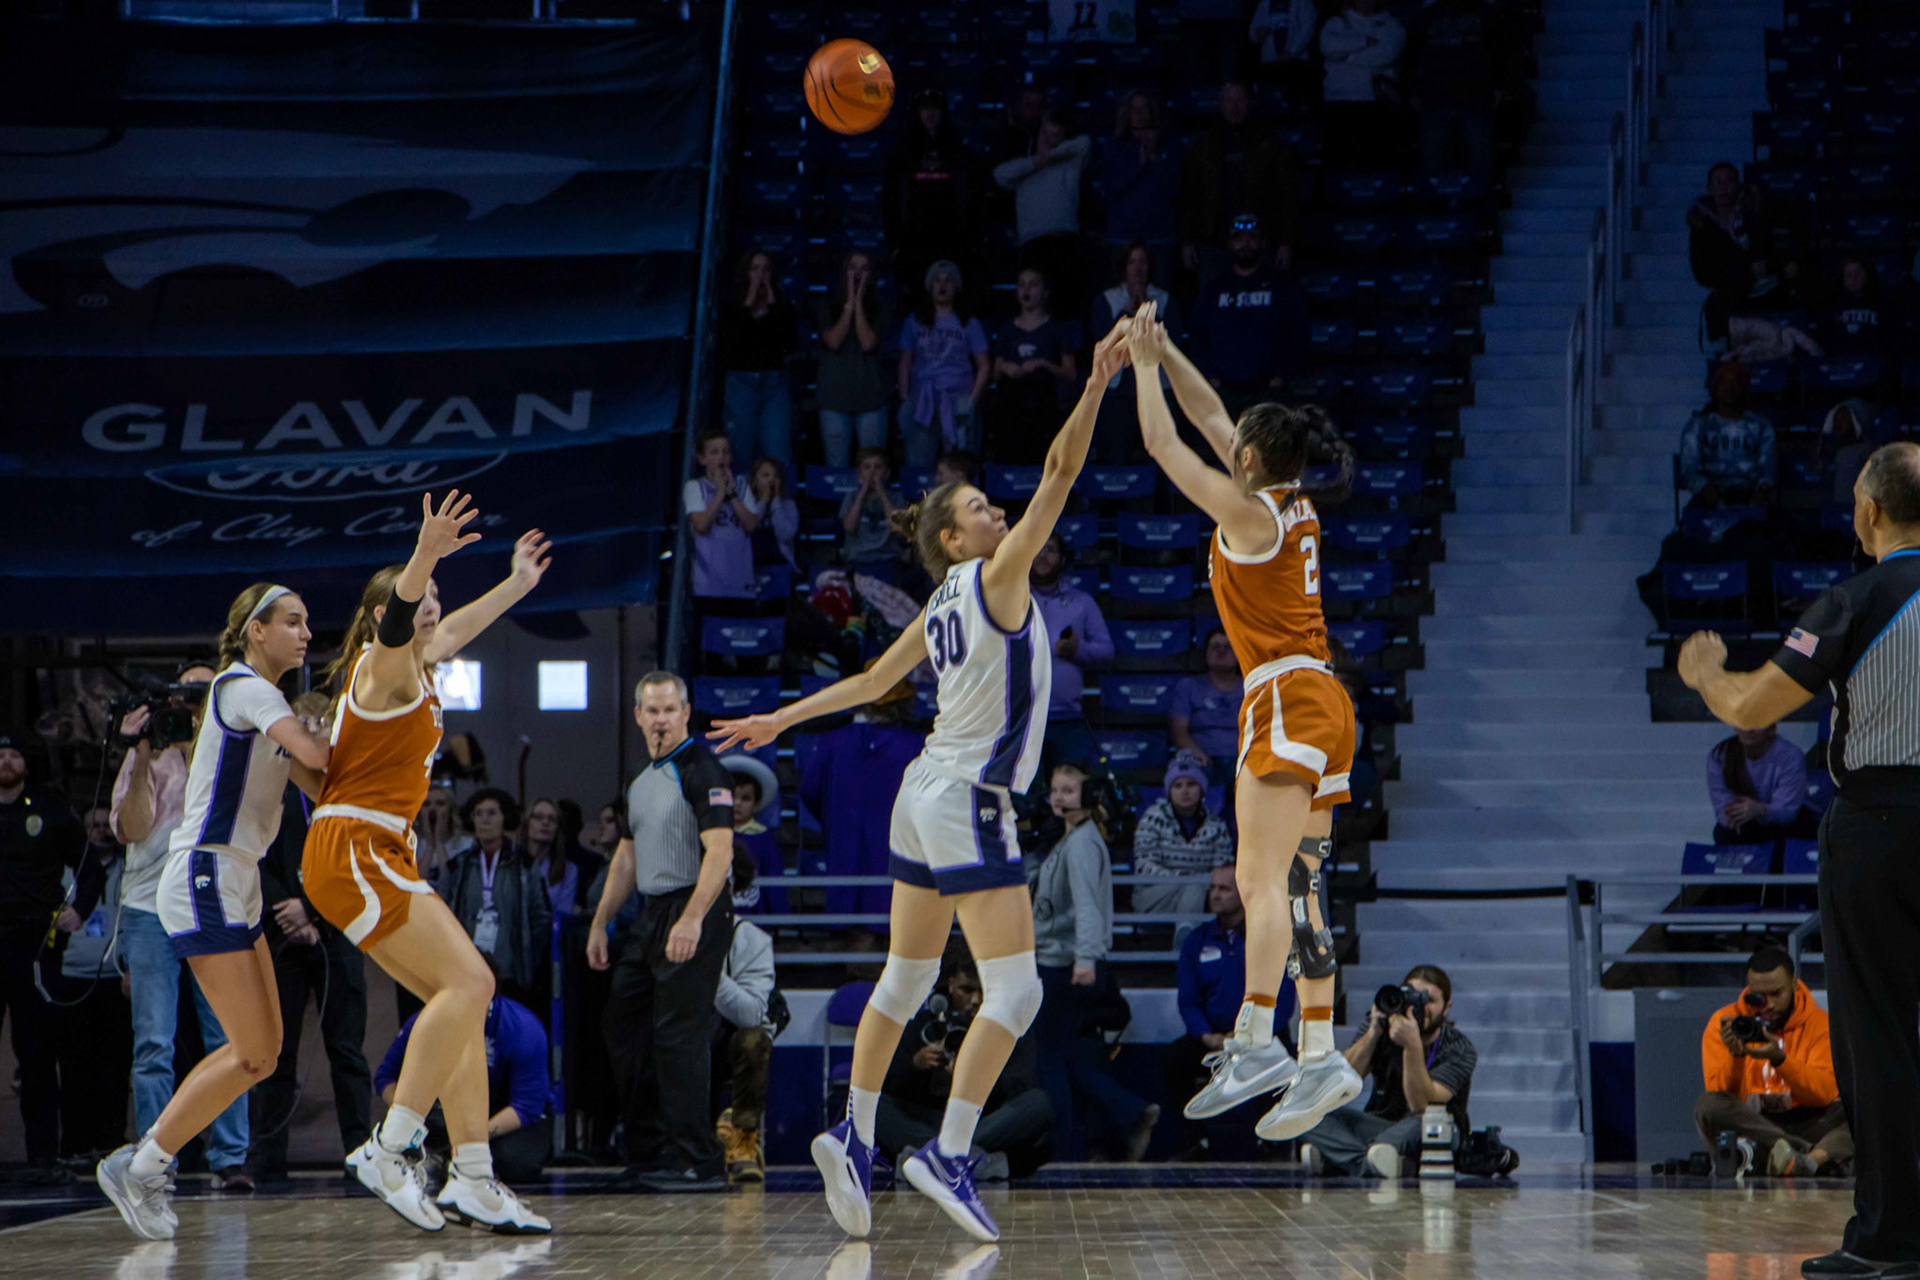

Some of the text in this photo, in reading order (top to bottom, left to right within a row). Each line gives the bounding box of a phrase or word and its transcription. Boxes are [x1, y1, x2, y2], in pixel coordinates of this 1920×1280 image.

[81, 390, 593, 453] GLAVAN
[131, 519, 202, 548] of
[211, 512, 329, 548] Clay
[1299, 534, 1319, 596] 2
[927, 609, 967, 673] 30
